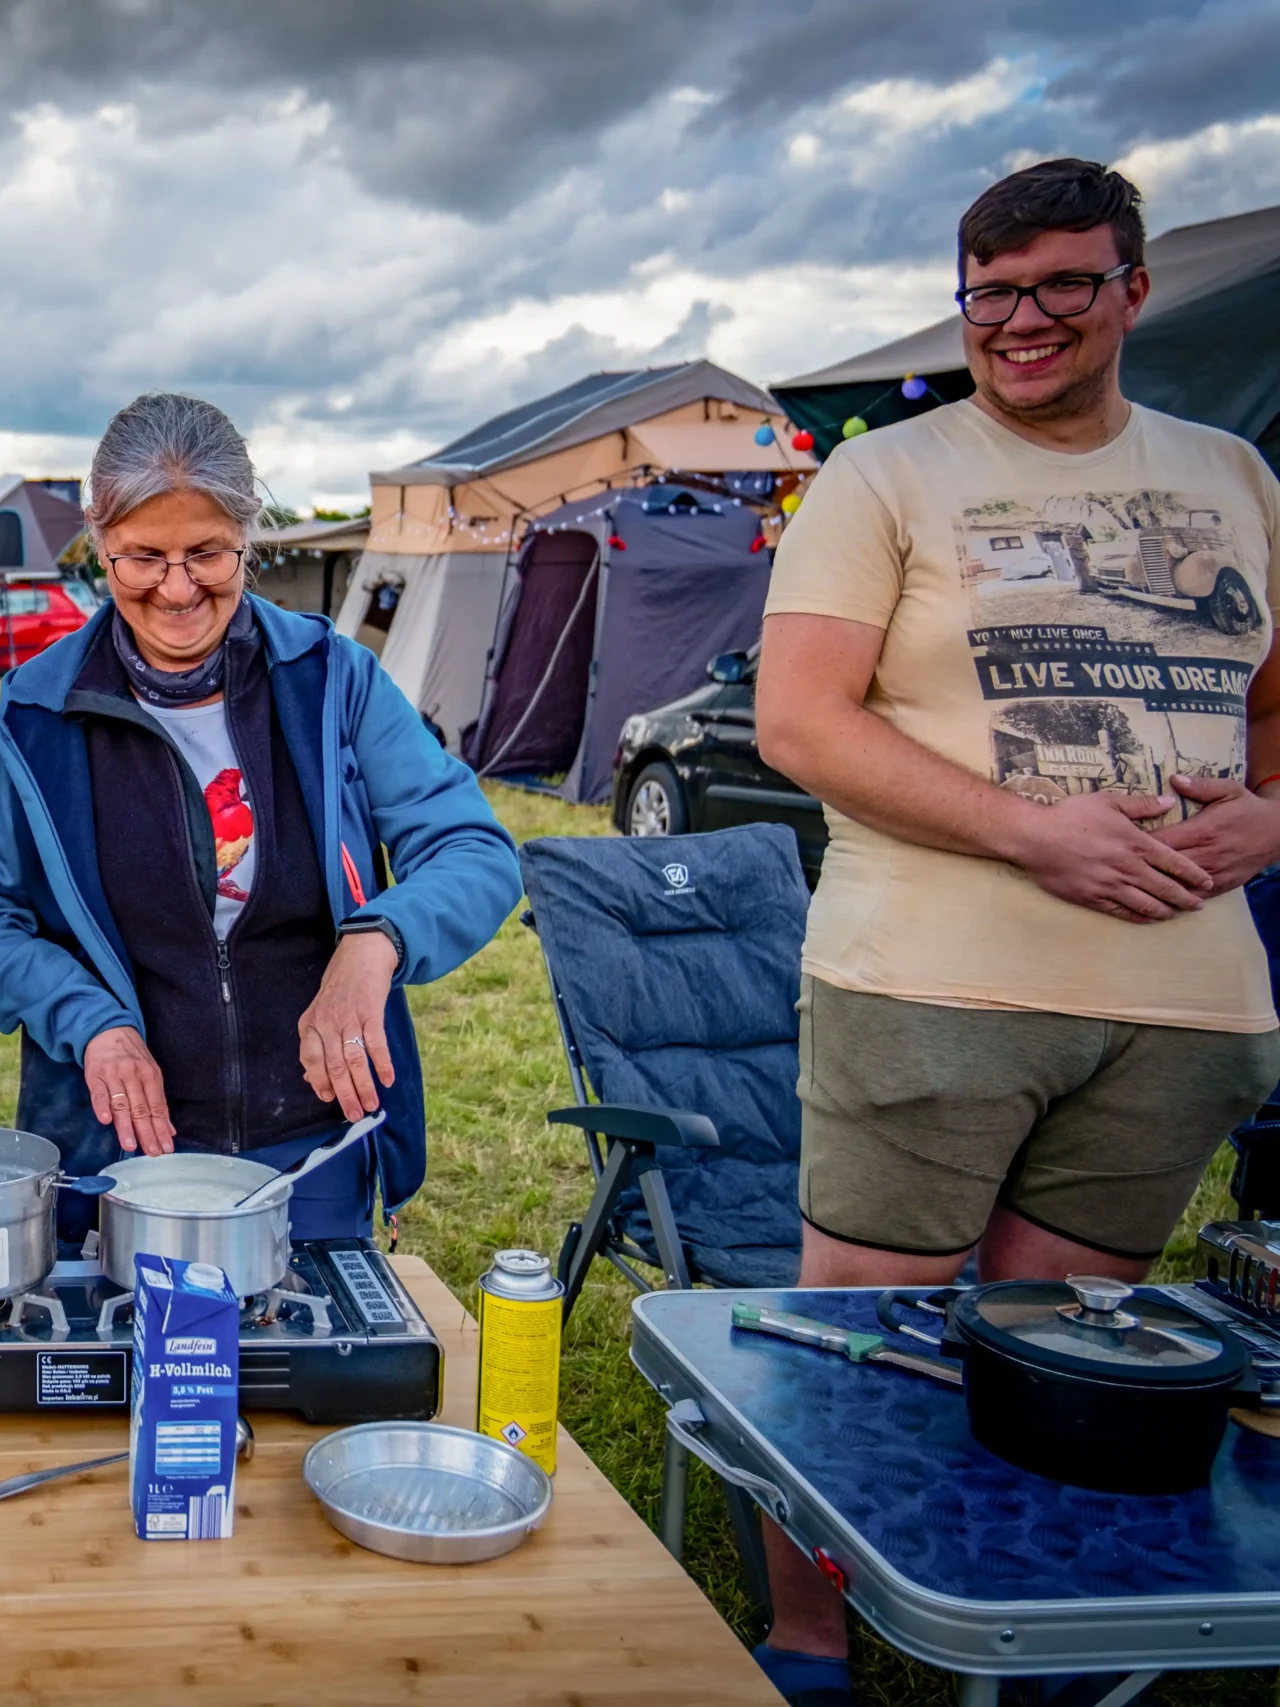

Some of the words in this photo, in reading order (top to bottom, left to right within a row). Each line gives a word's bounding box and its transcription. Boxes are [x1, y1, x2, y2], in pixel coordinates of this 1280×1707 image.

[1037, 627, 1070, 639] LIVE
[1072, 628, 1105, 641] ONCE
[989, 661, 1074, 691] LIVE
[1081, 661, 1166, 692] YOUR
[169, 1339, 213, 1354] Landfein
[149, 1362, 232, 1378] H-Vollmilch
[187, 1384, 195, 1394] %
[196, 1385, 214, 1394] Fett
